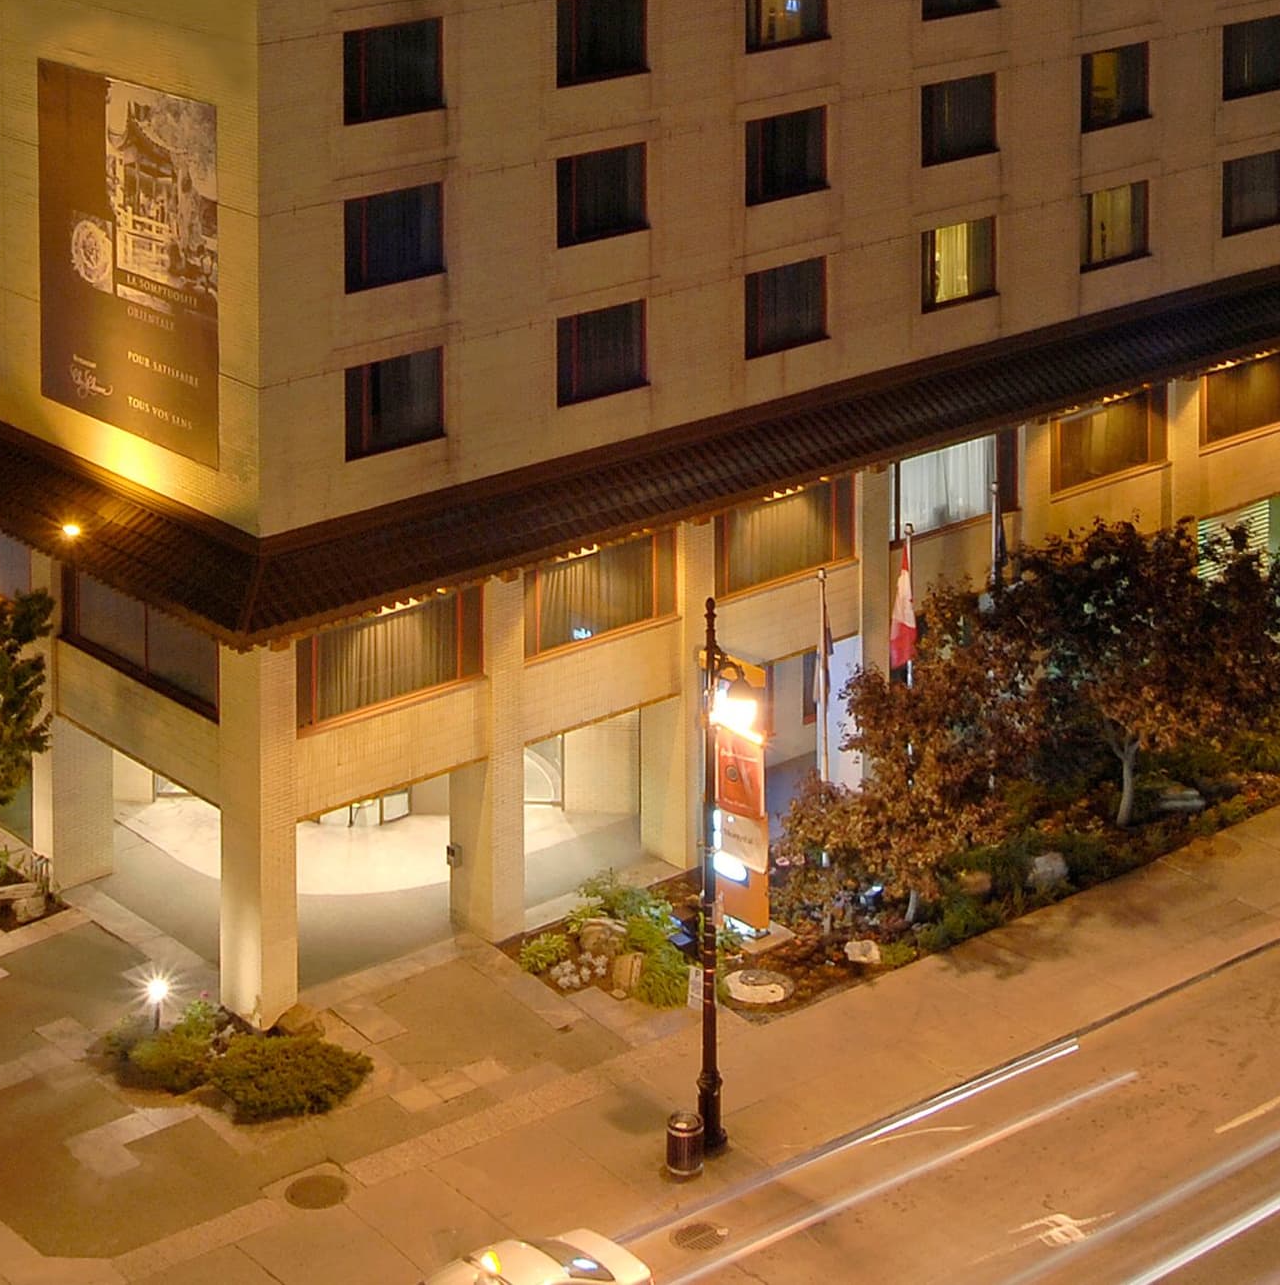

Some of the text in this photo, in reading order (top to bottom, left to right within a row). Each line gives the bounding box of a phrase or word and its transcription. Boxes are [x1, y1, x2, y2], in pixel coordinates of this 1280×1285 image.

[127, 306, 175, 331] ORIENTALE
[127, 351, 199, 388] POUR SATISFAIRE
[127, 395, 192, 430] TOUS VOS SENS
